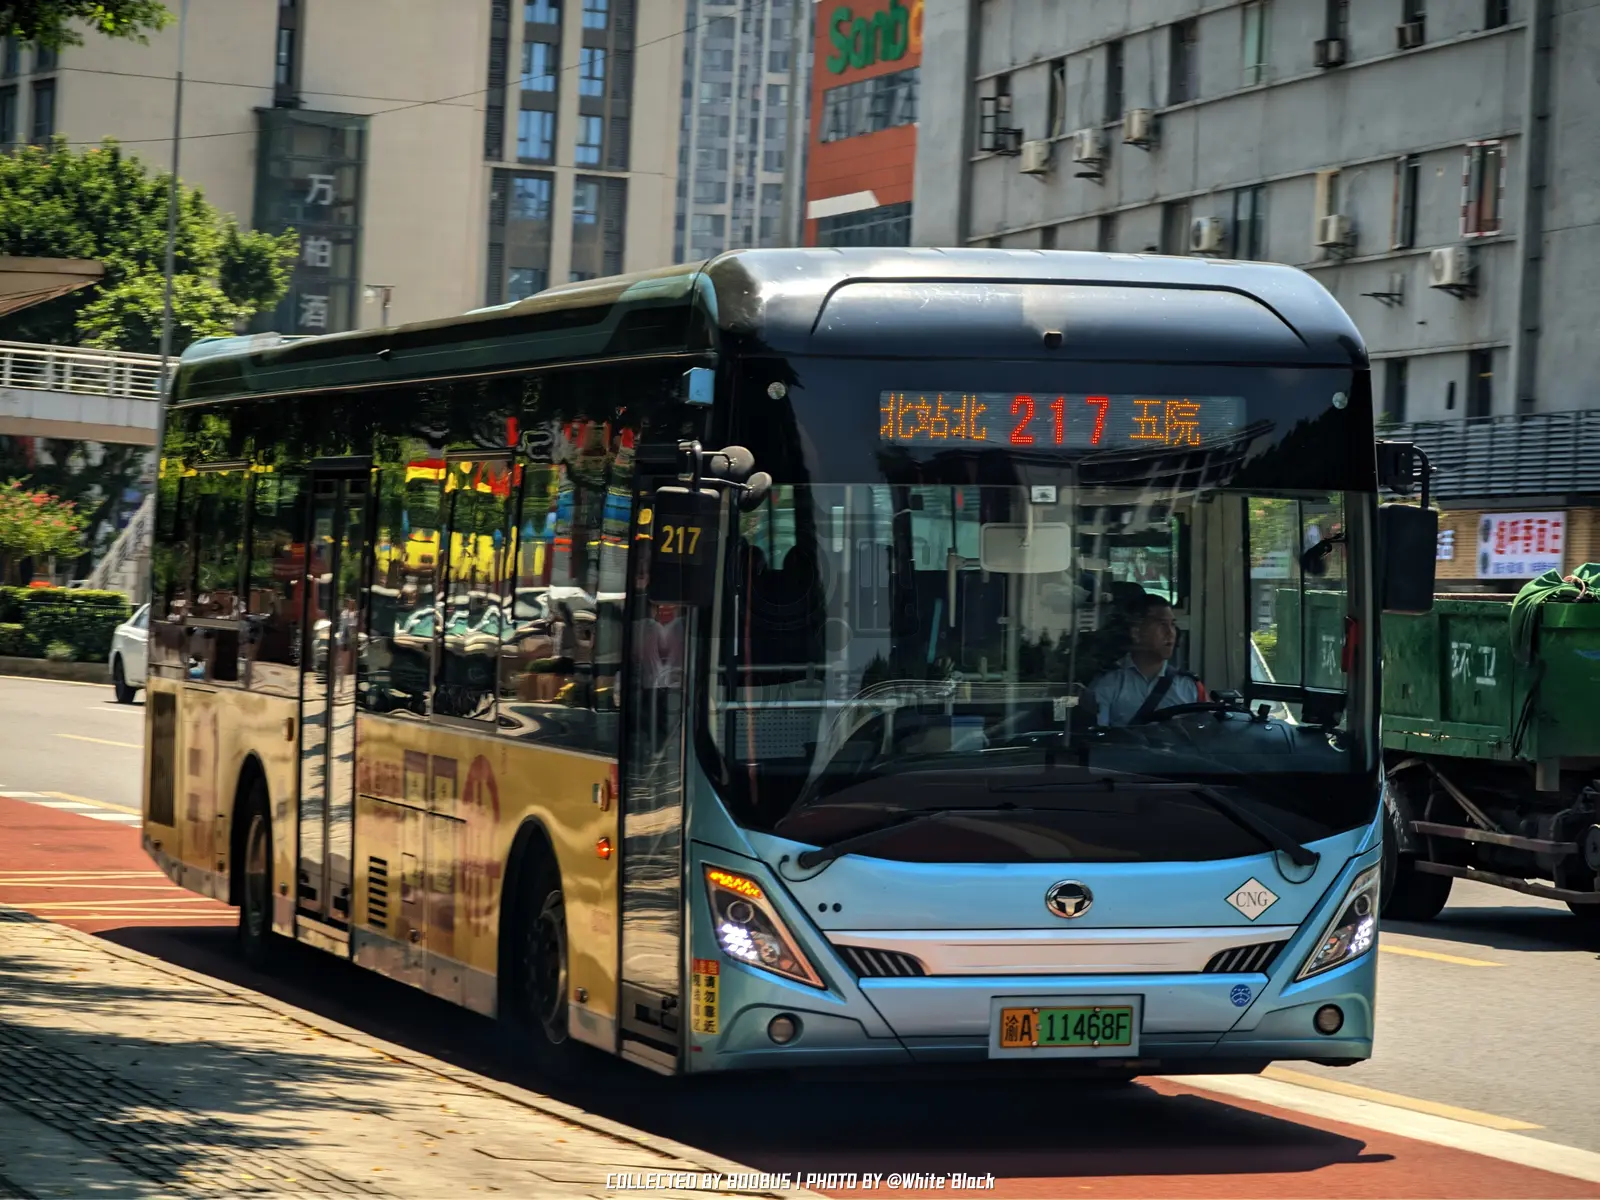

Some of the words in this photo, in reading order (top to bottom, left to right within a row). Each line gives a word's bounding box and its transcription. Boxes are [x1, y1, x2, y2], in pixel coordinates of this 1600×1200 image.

[879, 392, 987, 440] 北站北
[1010, 395, 1109, 445] 217
[1129, 398, 1201, 446] 五院
[661, 525, 702, 554] 217
[1451, 641, 1497, 686] 环卫
[1235, 891, 1268, 907] CNG
